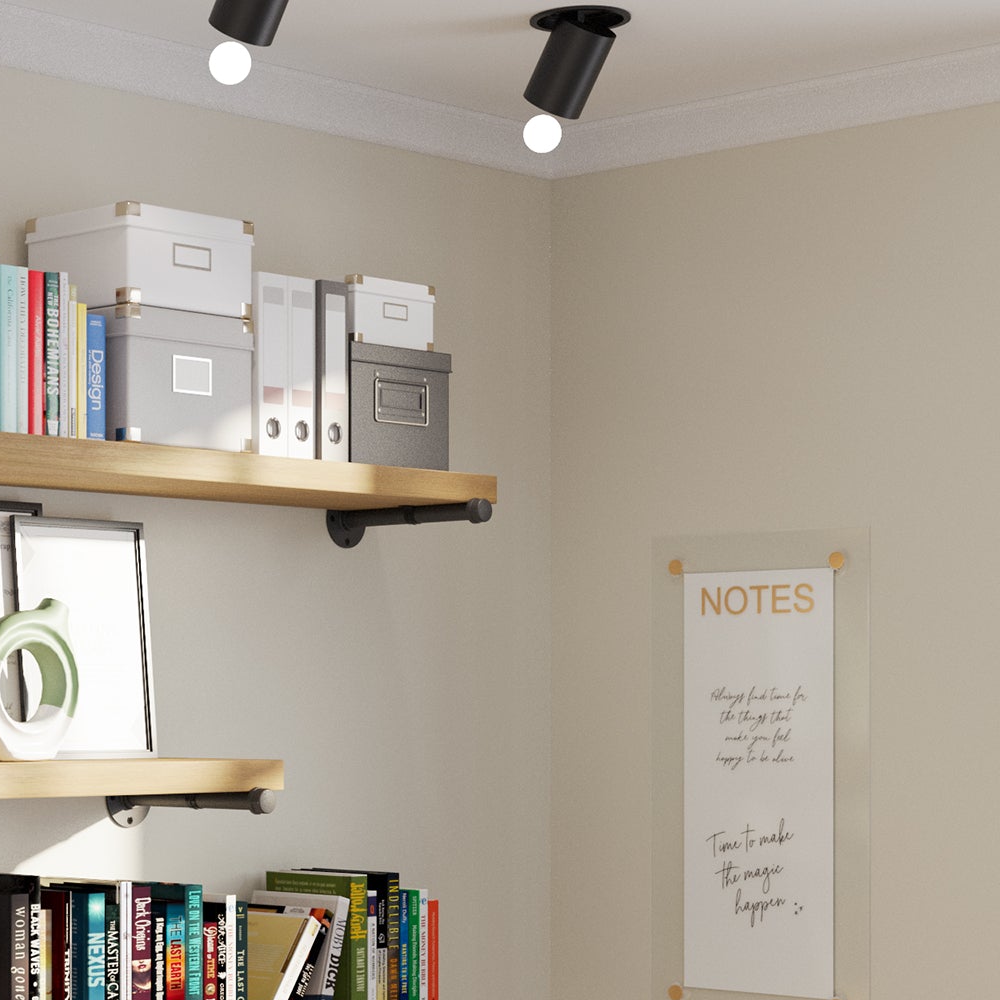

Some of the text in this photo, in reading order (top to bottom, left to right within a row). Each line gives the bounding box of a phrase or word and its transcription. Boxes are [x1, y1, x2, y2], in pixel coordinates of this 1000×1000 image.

[46, 308, 59, 396] BOHEMIANS
[88, 350, 104, 410] Design
[700, 583, 815, 616] NOTES
[710, 685, 807, 708] Always find time for
[720, 708, 793, 732] the things that
[725, 728, 791, 750] make you feel
[715, 749, 795, 770] happy to be alive
[706, 818, 794, 857] Time to make
[715, 861, 783, 894] the magic
[132, 897, 151, 951] Dark Origins
[350, 882, 368, 941] Harry Potter
[388, 879, 399, 950] INDELIBLE
[735, 888, 785, 928] happen
[11, 906, 27, 1000] woman gone
[30, 904, 40, 975] BLACK WAVES
[107, 930, 119, 976] MASTER
[170, 916, 182, 990] THE LAST EARTH
[188, 890, 202, 995] LOVE ON THE WESTERN FRONT
[334, 917, 349, 957] MOBY
[88, 932, 105, 987] NEXUS
[206, 959, 215, 979] TIME
[237, 950, 245, 969] THE
[325, 953, 341, 991] DICK
[356, 947, 365, 992] JOANNE ROWLING
[389, 958, 398, 980] DAWN
[401, 966, 407, 974] TO
[401, 974, 407, 982] BE
